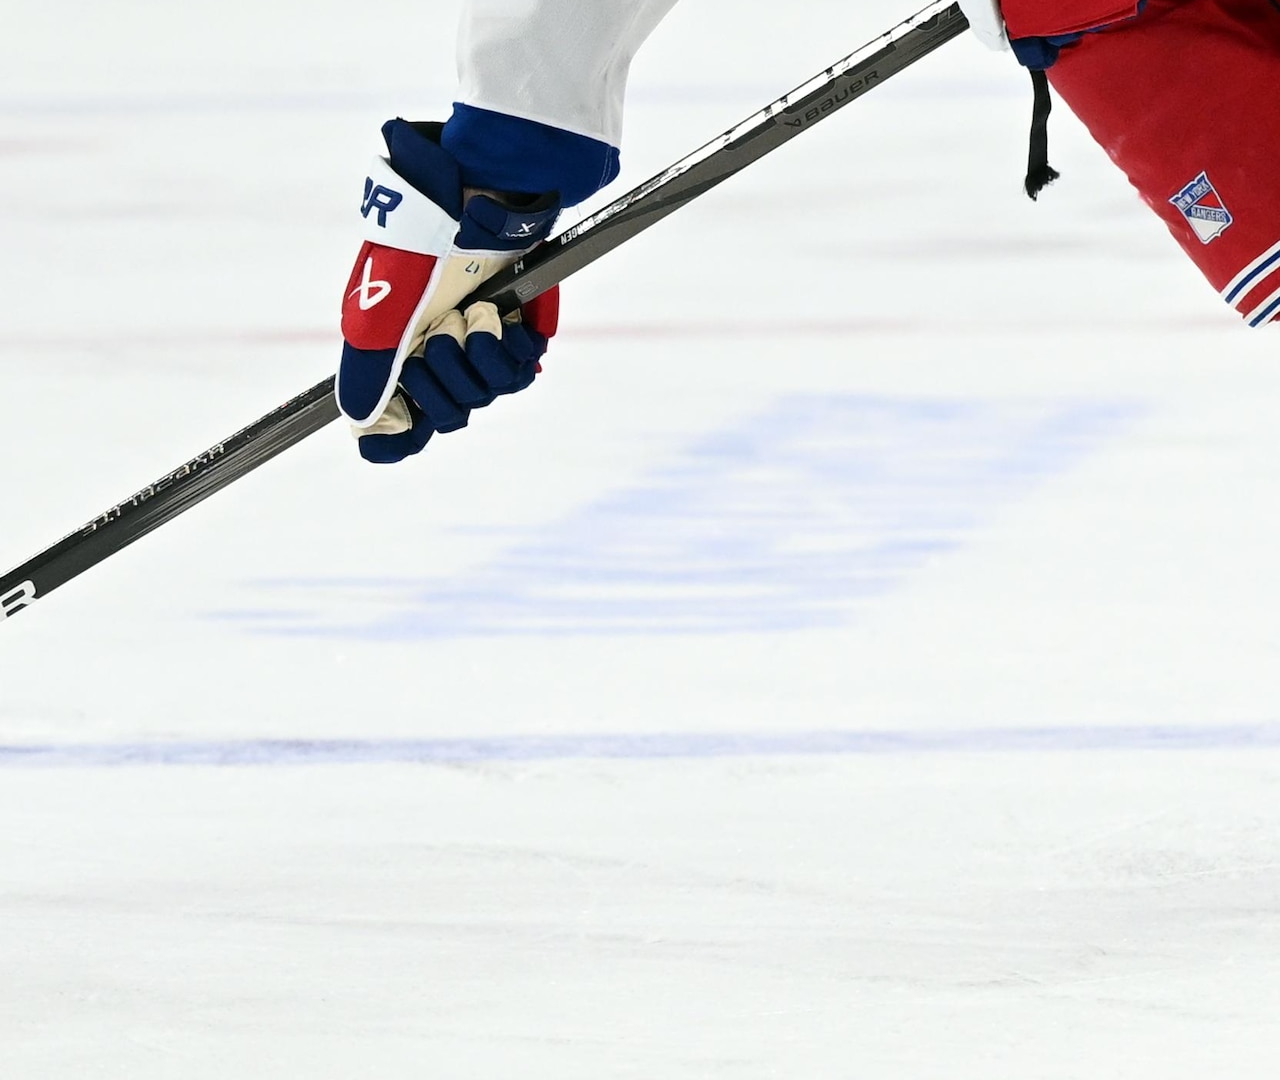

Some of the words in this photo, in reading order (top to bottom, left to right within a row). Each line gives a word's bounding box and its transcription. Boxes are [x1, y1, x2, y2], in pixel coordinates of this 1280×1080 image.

[805, 70, 880, 122] BAUER
[1176, 193, 1192, 209] NEW
[1190, 179, 1210, 199] YORK
[1190, 206, 1227, 223] RANGERS
